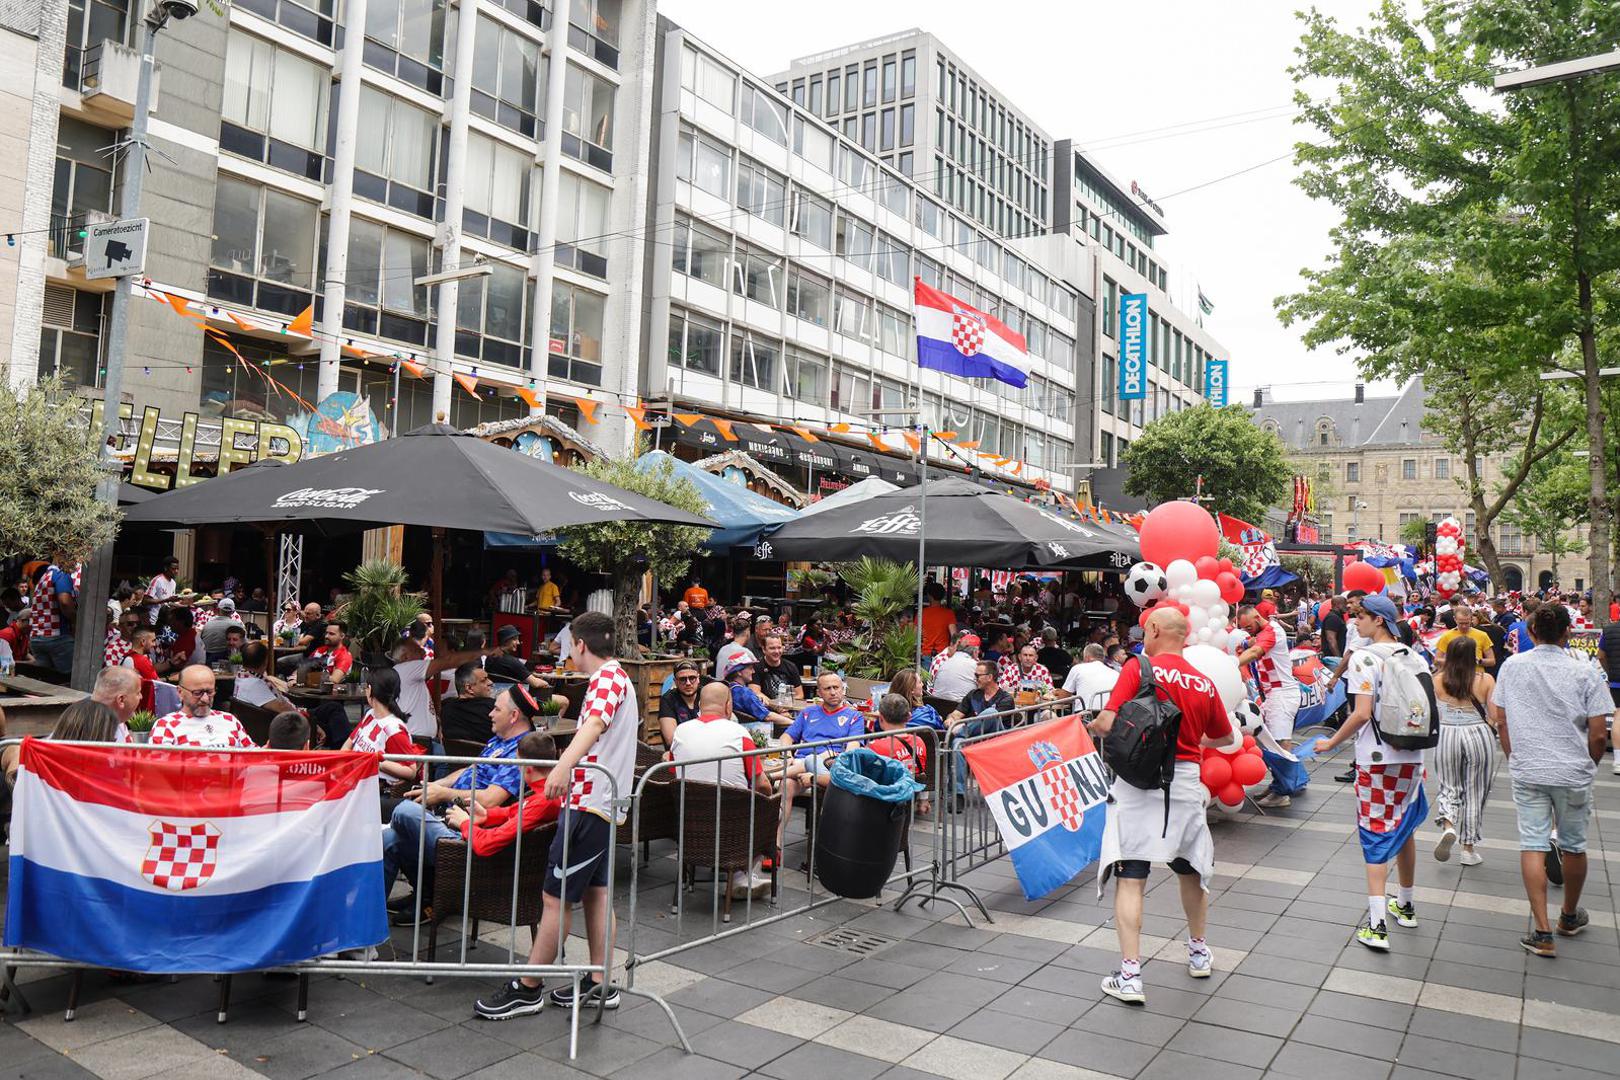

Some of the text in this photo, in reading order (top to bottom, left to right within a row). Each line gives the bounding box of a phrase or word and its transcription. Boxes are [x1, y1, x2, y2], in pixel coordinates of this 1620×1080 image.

[93, 223, 142, 237] Cameratoezicht
[1125, 299, 1141, 394] DECATHLON
[1210, 364, 1223, 410] THLON
[848, 513, 922, 534] Leffe
[1001, 778, 1049, 838] GU
